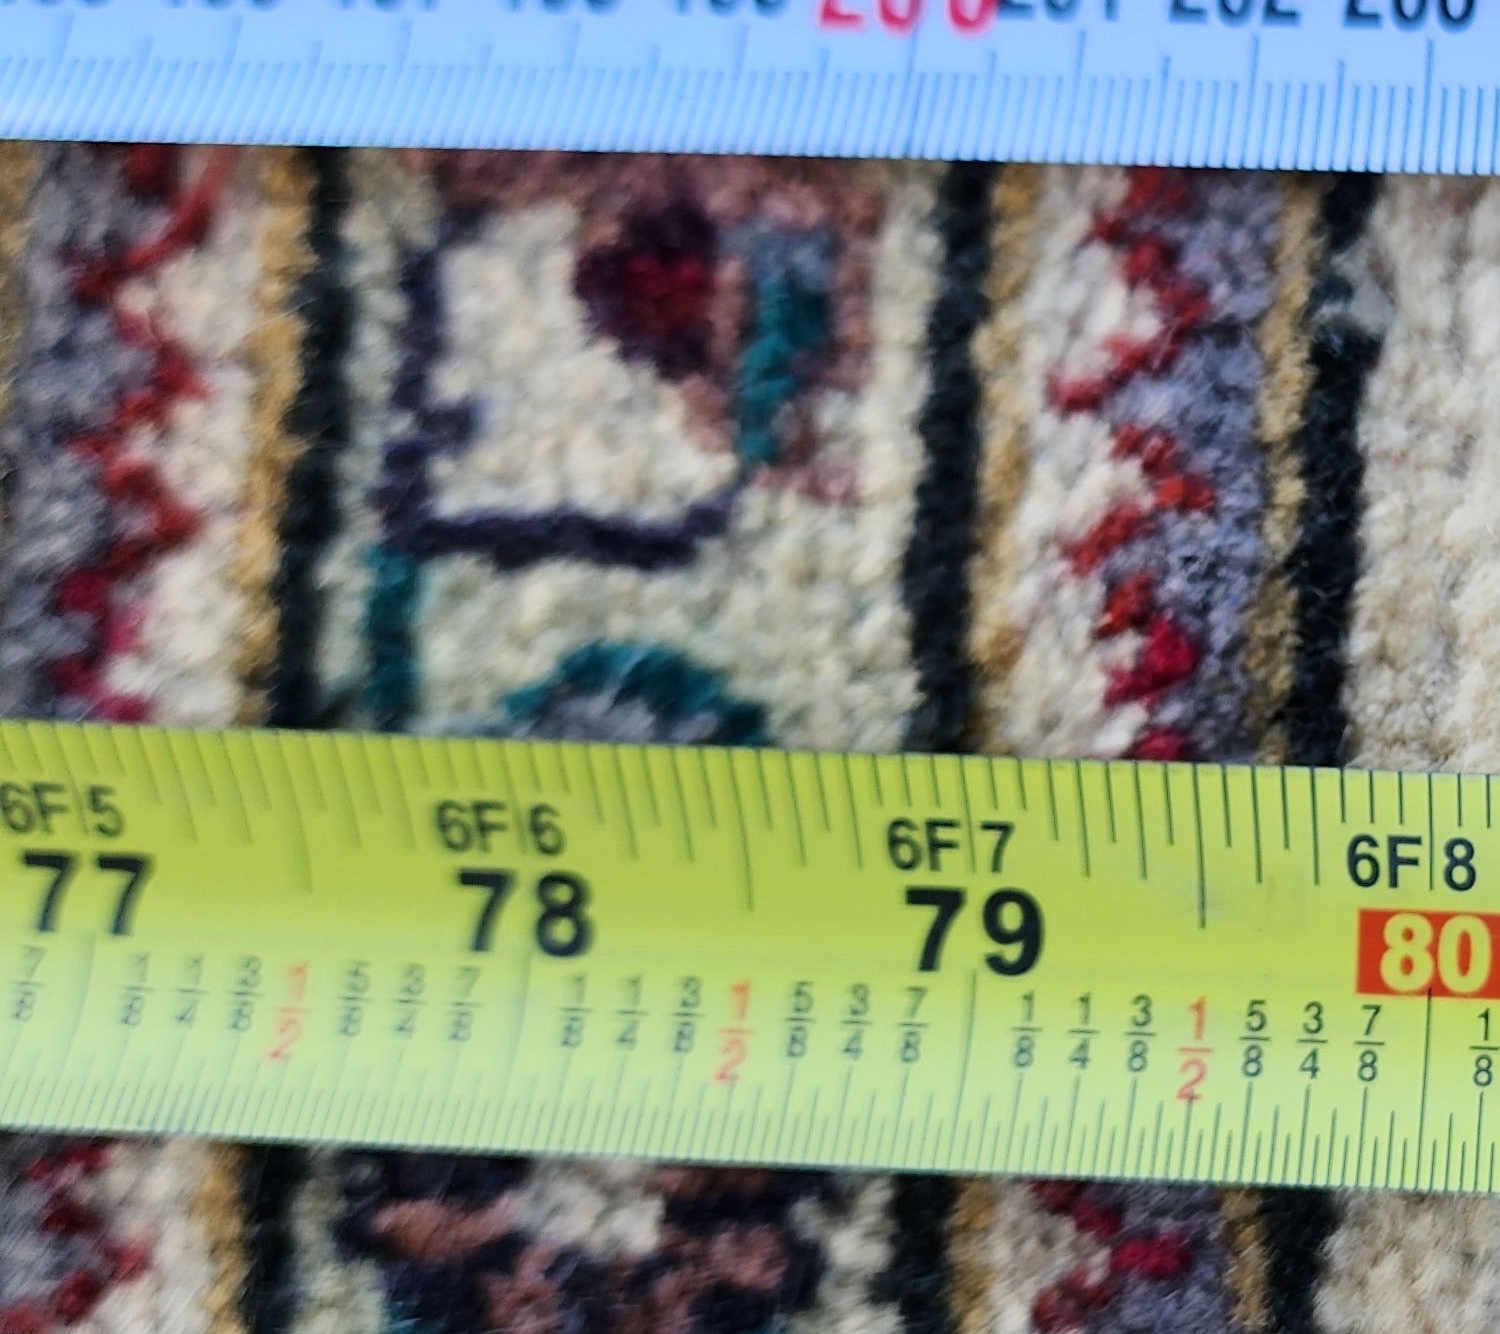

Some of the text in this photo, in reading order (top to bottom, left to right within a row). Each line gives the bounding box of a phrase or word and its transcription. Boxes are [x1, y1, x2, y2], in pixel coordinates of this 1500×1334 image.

[22, 849, 153, 937] 77
[456, 867, 594, 958] 78
[903, 884, 1044, 976] 79
[1378, 913, 1494, 993] 80
